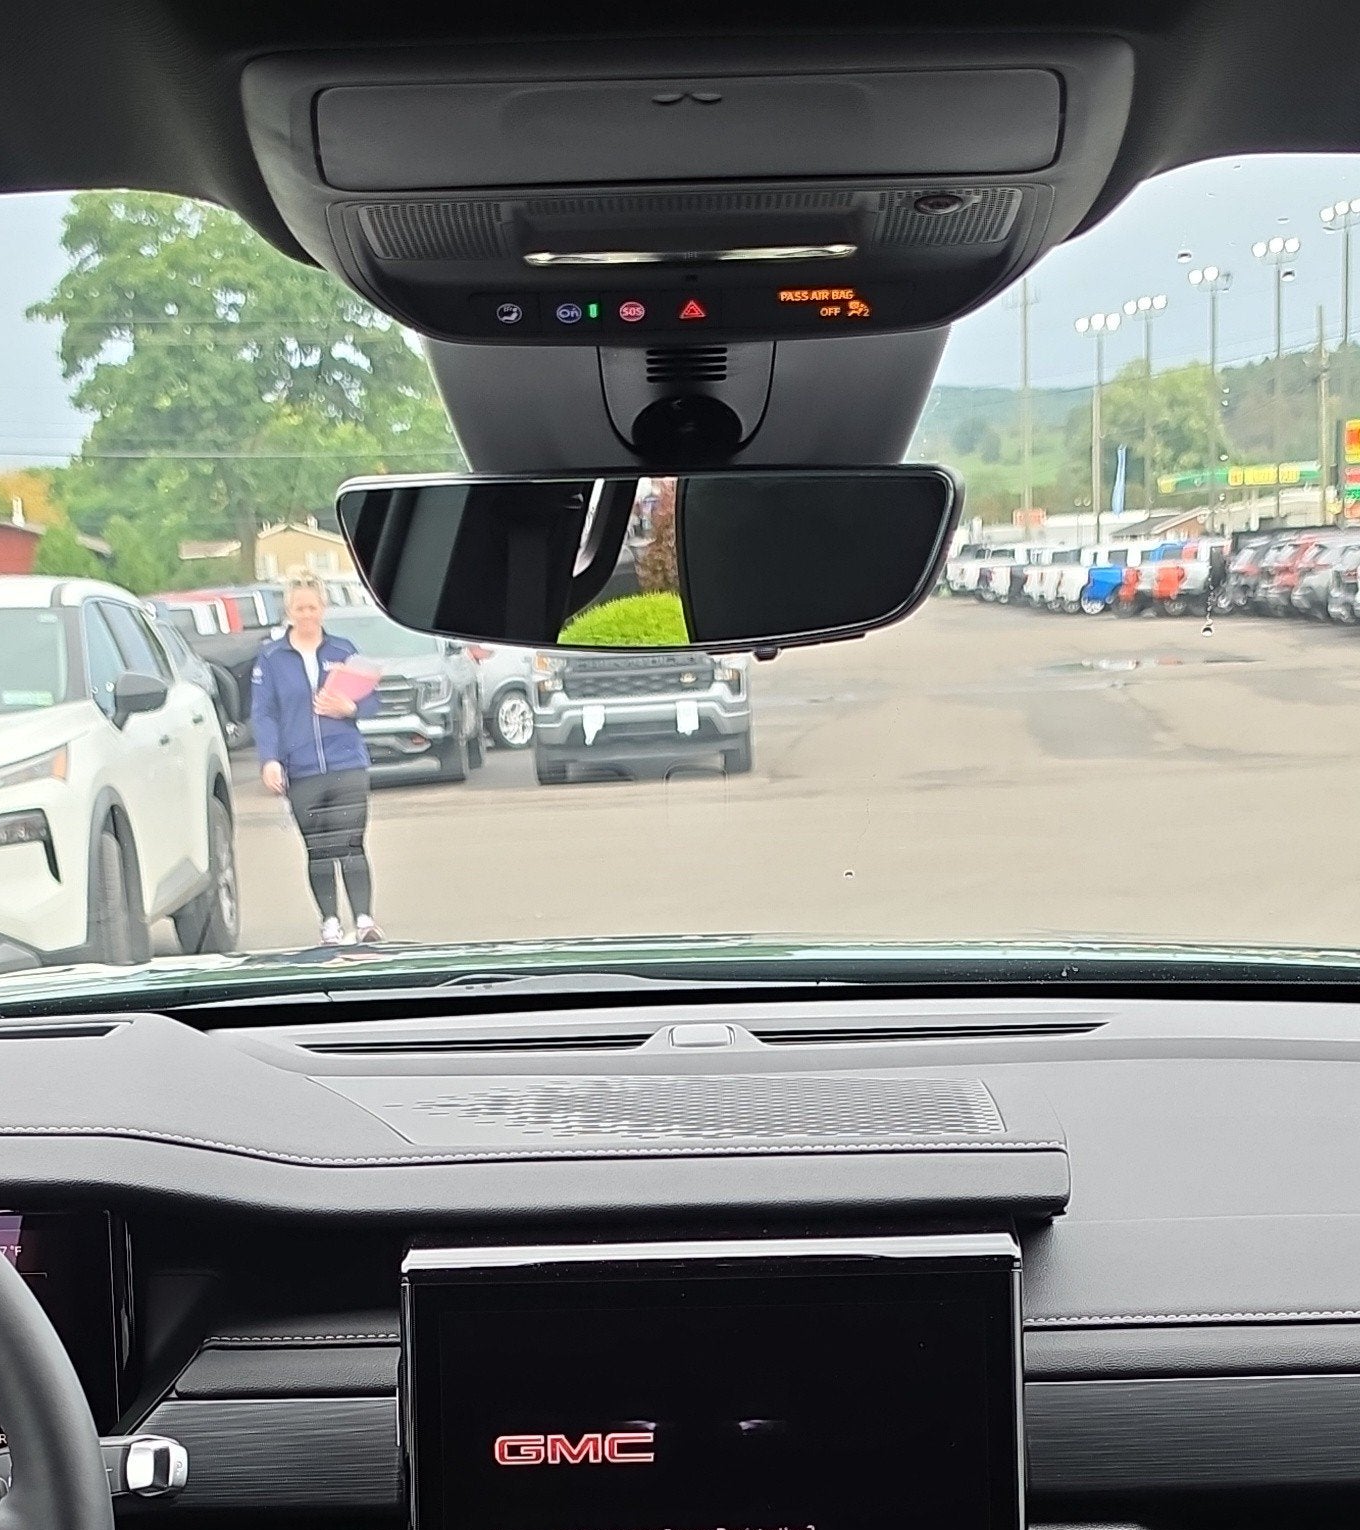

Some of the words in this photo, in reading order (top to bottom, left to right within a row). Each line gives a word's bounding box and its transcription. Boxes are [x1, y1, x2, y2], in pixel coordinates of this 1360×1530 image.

[780, 291, 809, 301] PASS
[810, 290, 830, 300] AIR
[831, 289, 854, 300] BAG
[622, 307, 642, 317] SOS
[819, 306, 841, 317] OFF
[495, 1432, 655, 1466] GMC
